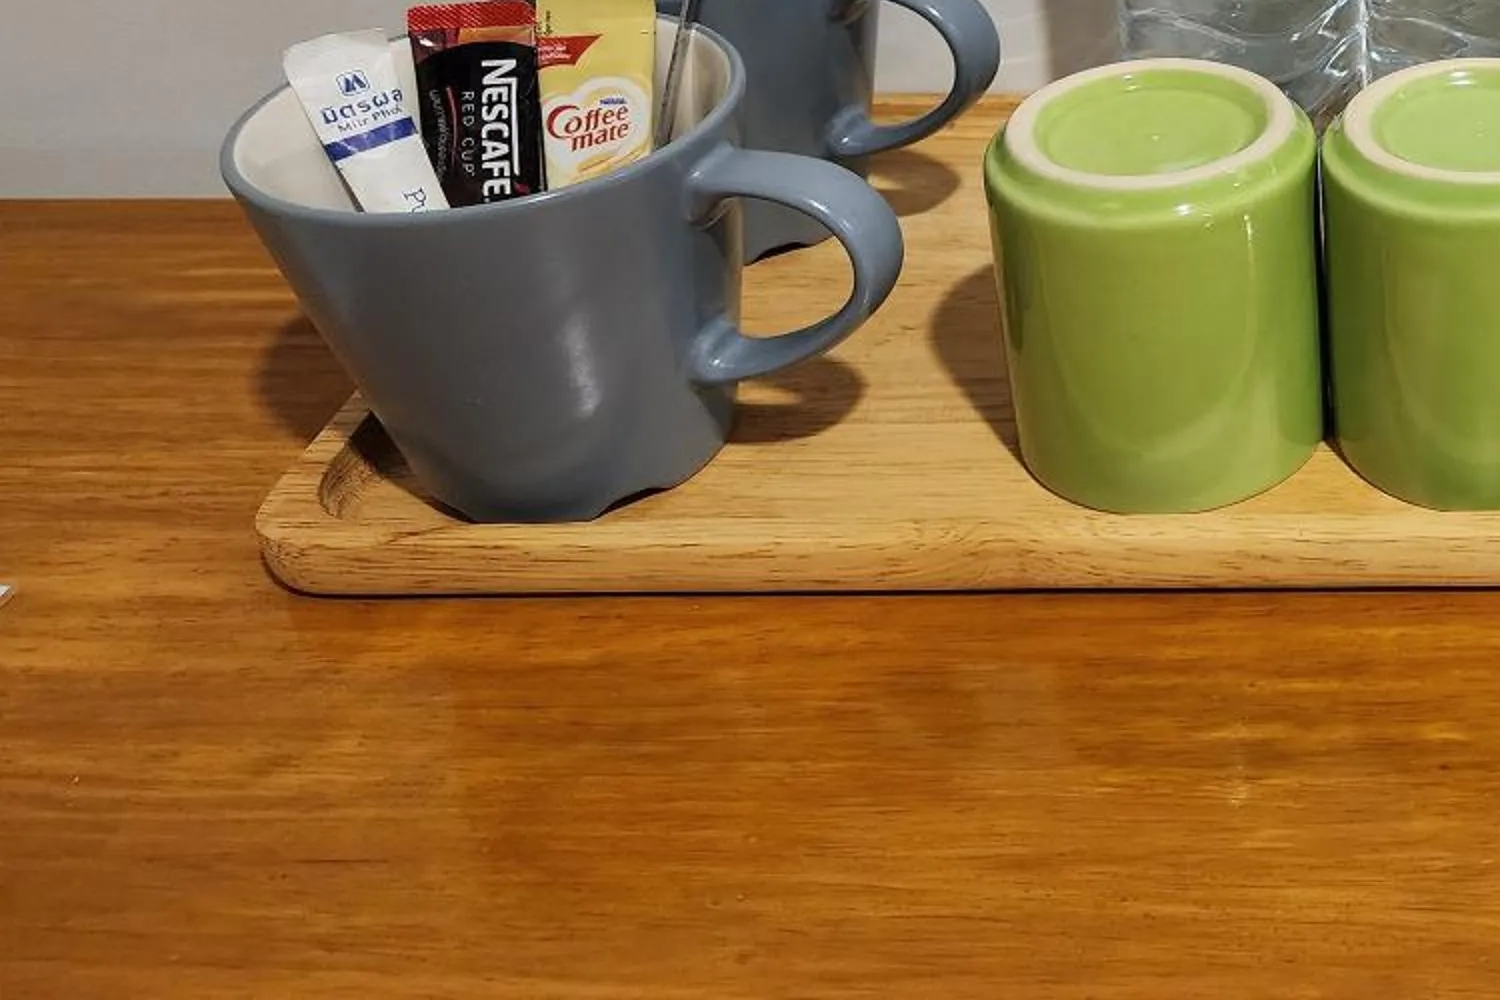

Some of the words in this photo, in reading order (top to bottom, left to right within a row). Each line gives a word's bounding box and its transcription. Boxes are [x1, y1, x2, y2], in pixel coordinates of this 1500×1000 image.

[461, 90, 475, 127] RED
[546, 104, 630, 140] Coffee
[461, 137, 475, 173] CUP
[570, 121, 630, 153] mate
